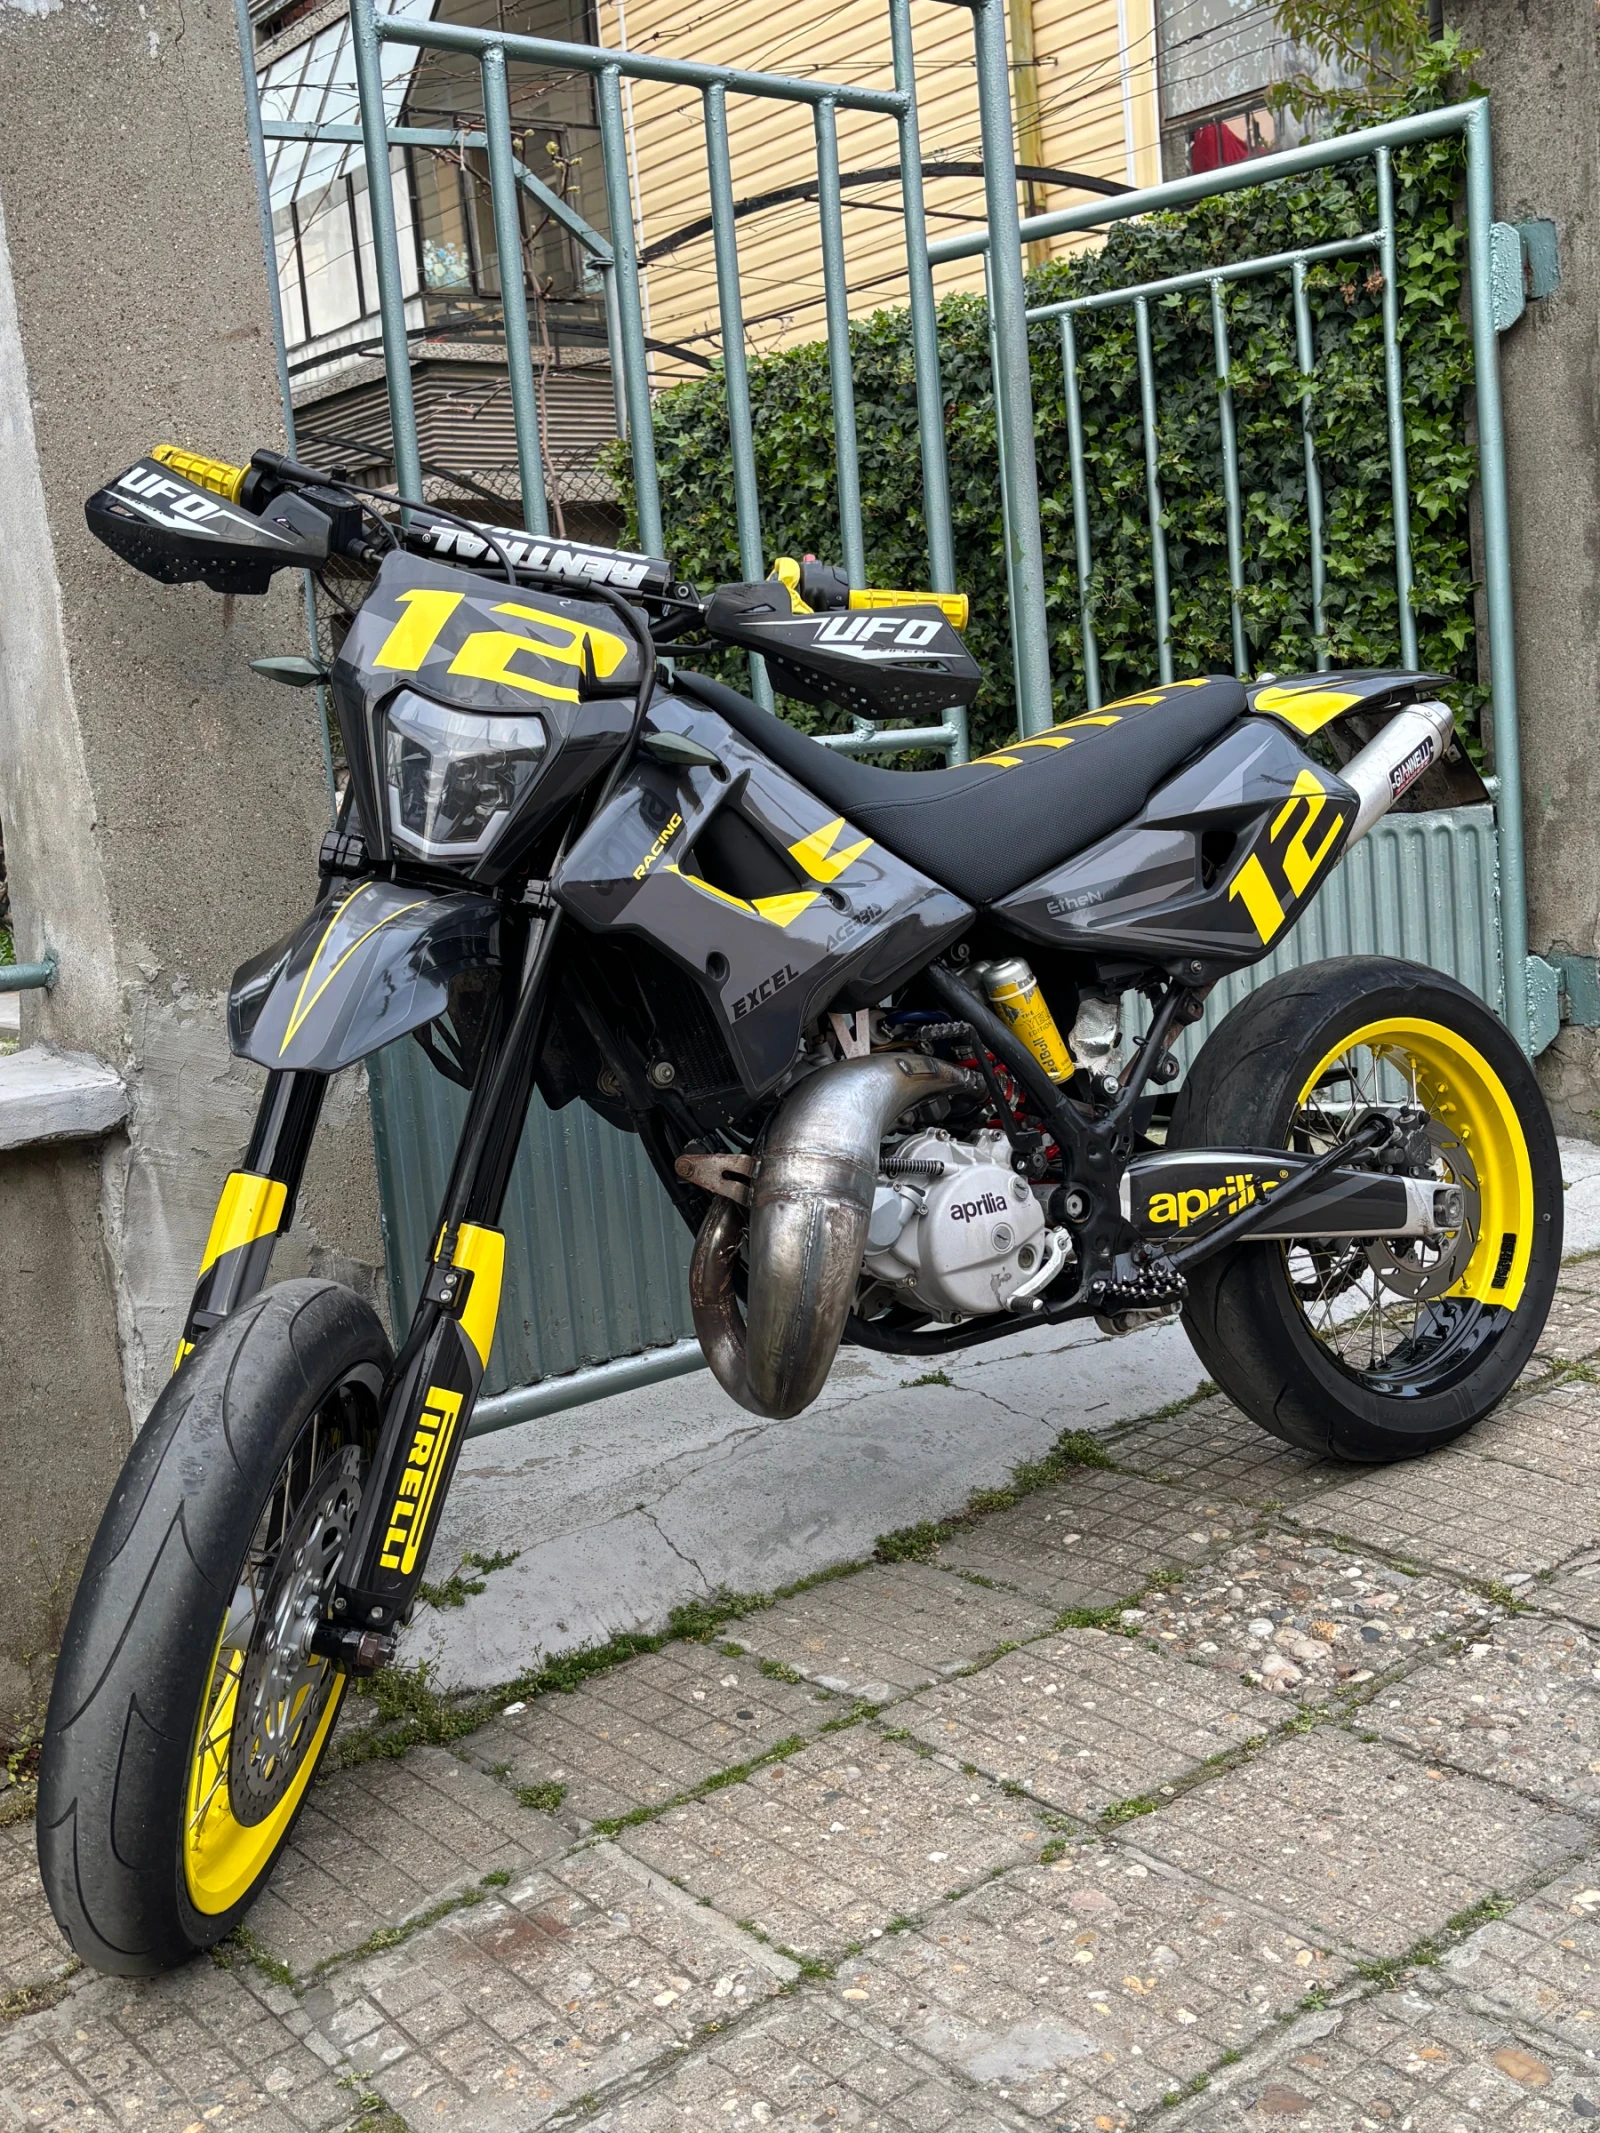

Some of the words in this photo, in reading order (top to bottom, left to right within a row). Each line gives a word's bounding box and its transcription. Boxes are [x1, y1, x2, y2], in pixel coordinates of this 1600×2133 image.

[117, 467, 200, 520] UFO
[429, 526, 649, 589] RENTHAL
[372, 589, 628, 706] 12
[819, 616, 943, 646] UFO
[1393, 741, 1431, 788] GIANNELLI
[633, 812, 683, 880] RACING
[1229, 769, 1344, 946] 12
[731, 964, 800, 1020] EXCEL
[950, 1192, 1008, 1223] aprilia
[379, 1386, 464, 1575] PIRELLI
